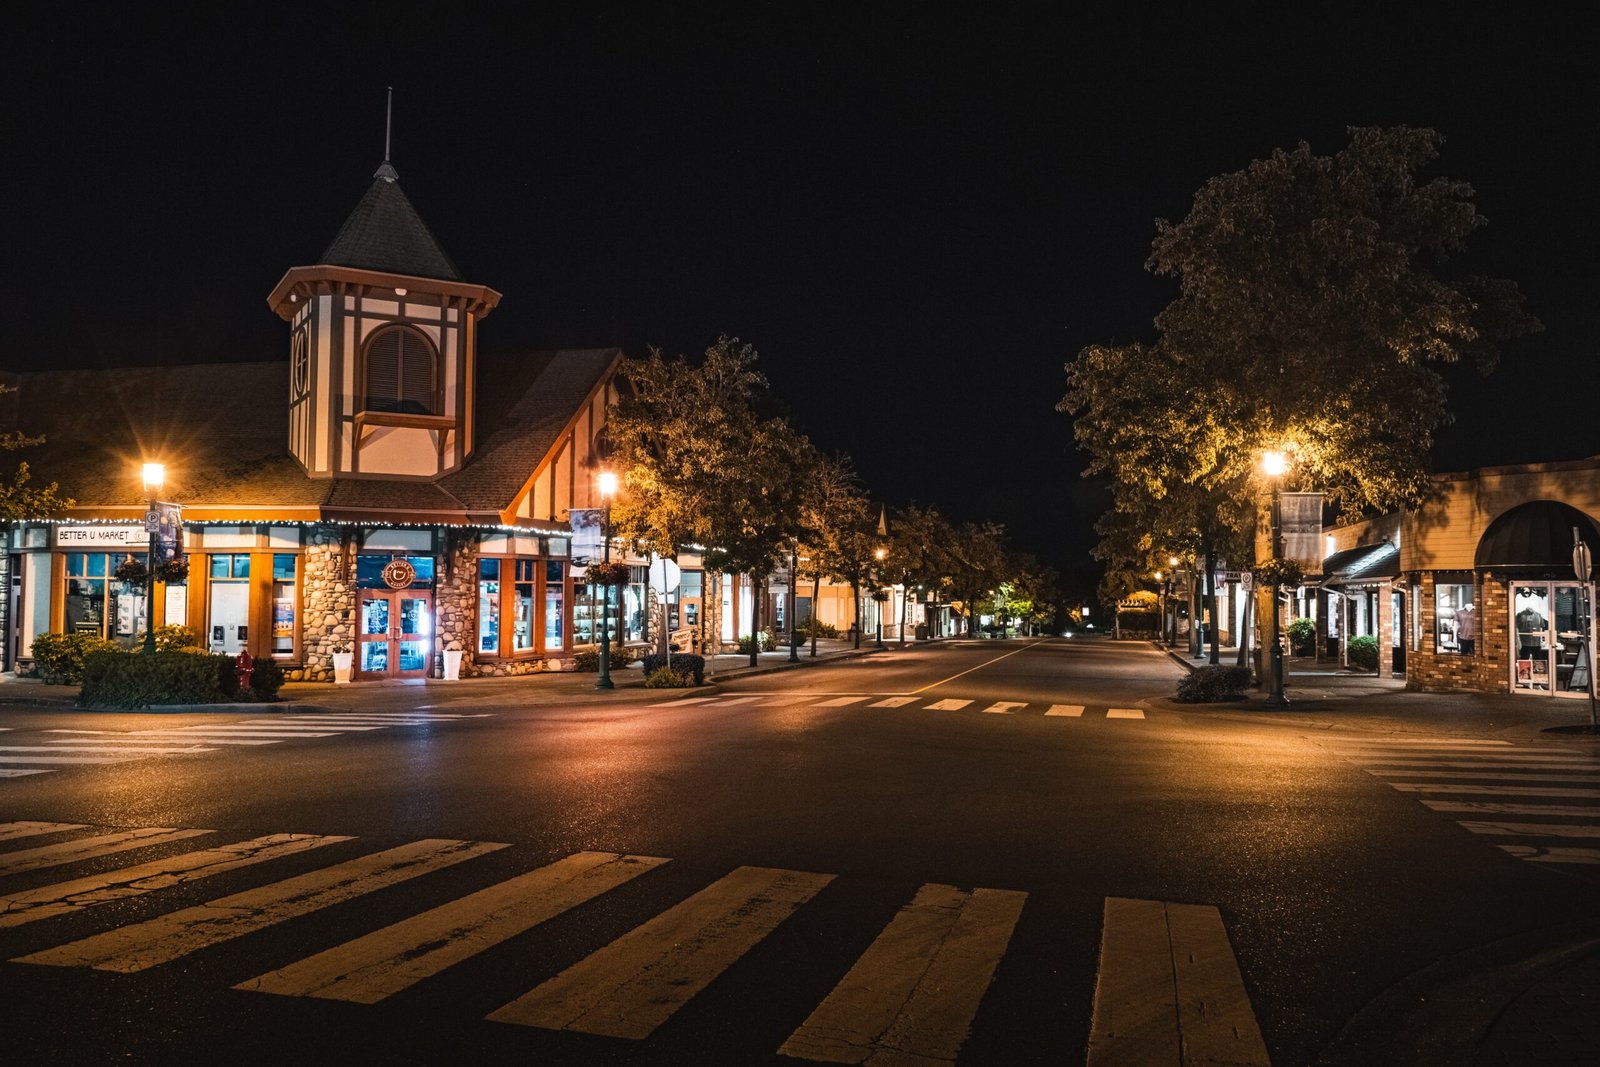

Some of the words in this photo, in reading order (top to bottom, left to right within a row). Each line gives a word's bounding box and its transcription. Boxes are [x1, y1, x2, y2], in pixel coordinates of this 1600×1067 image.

[60, 531, 87, 540] BETTER
[90, 531, 95, 540] U
[98, 531, 129, 540] MARKET
